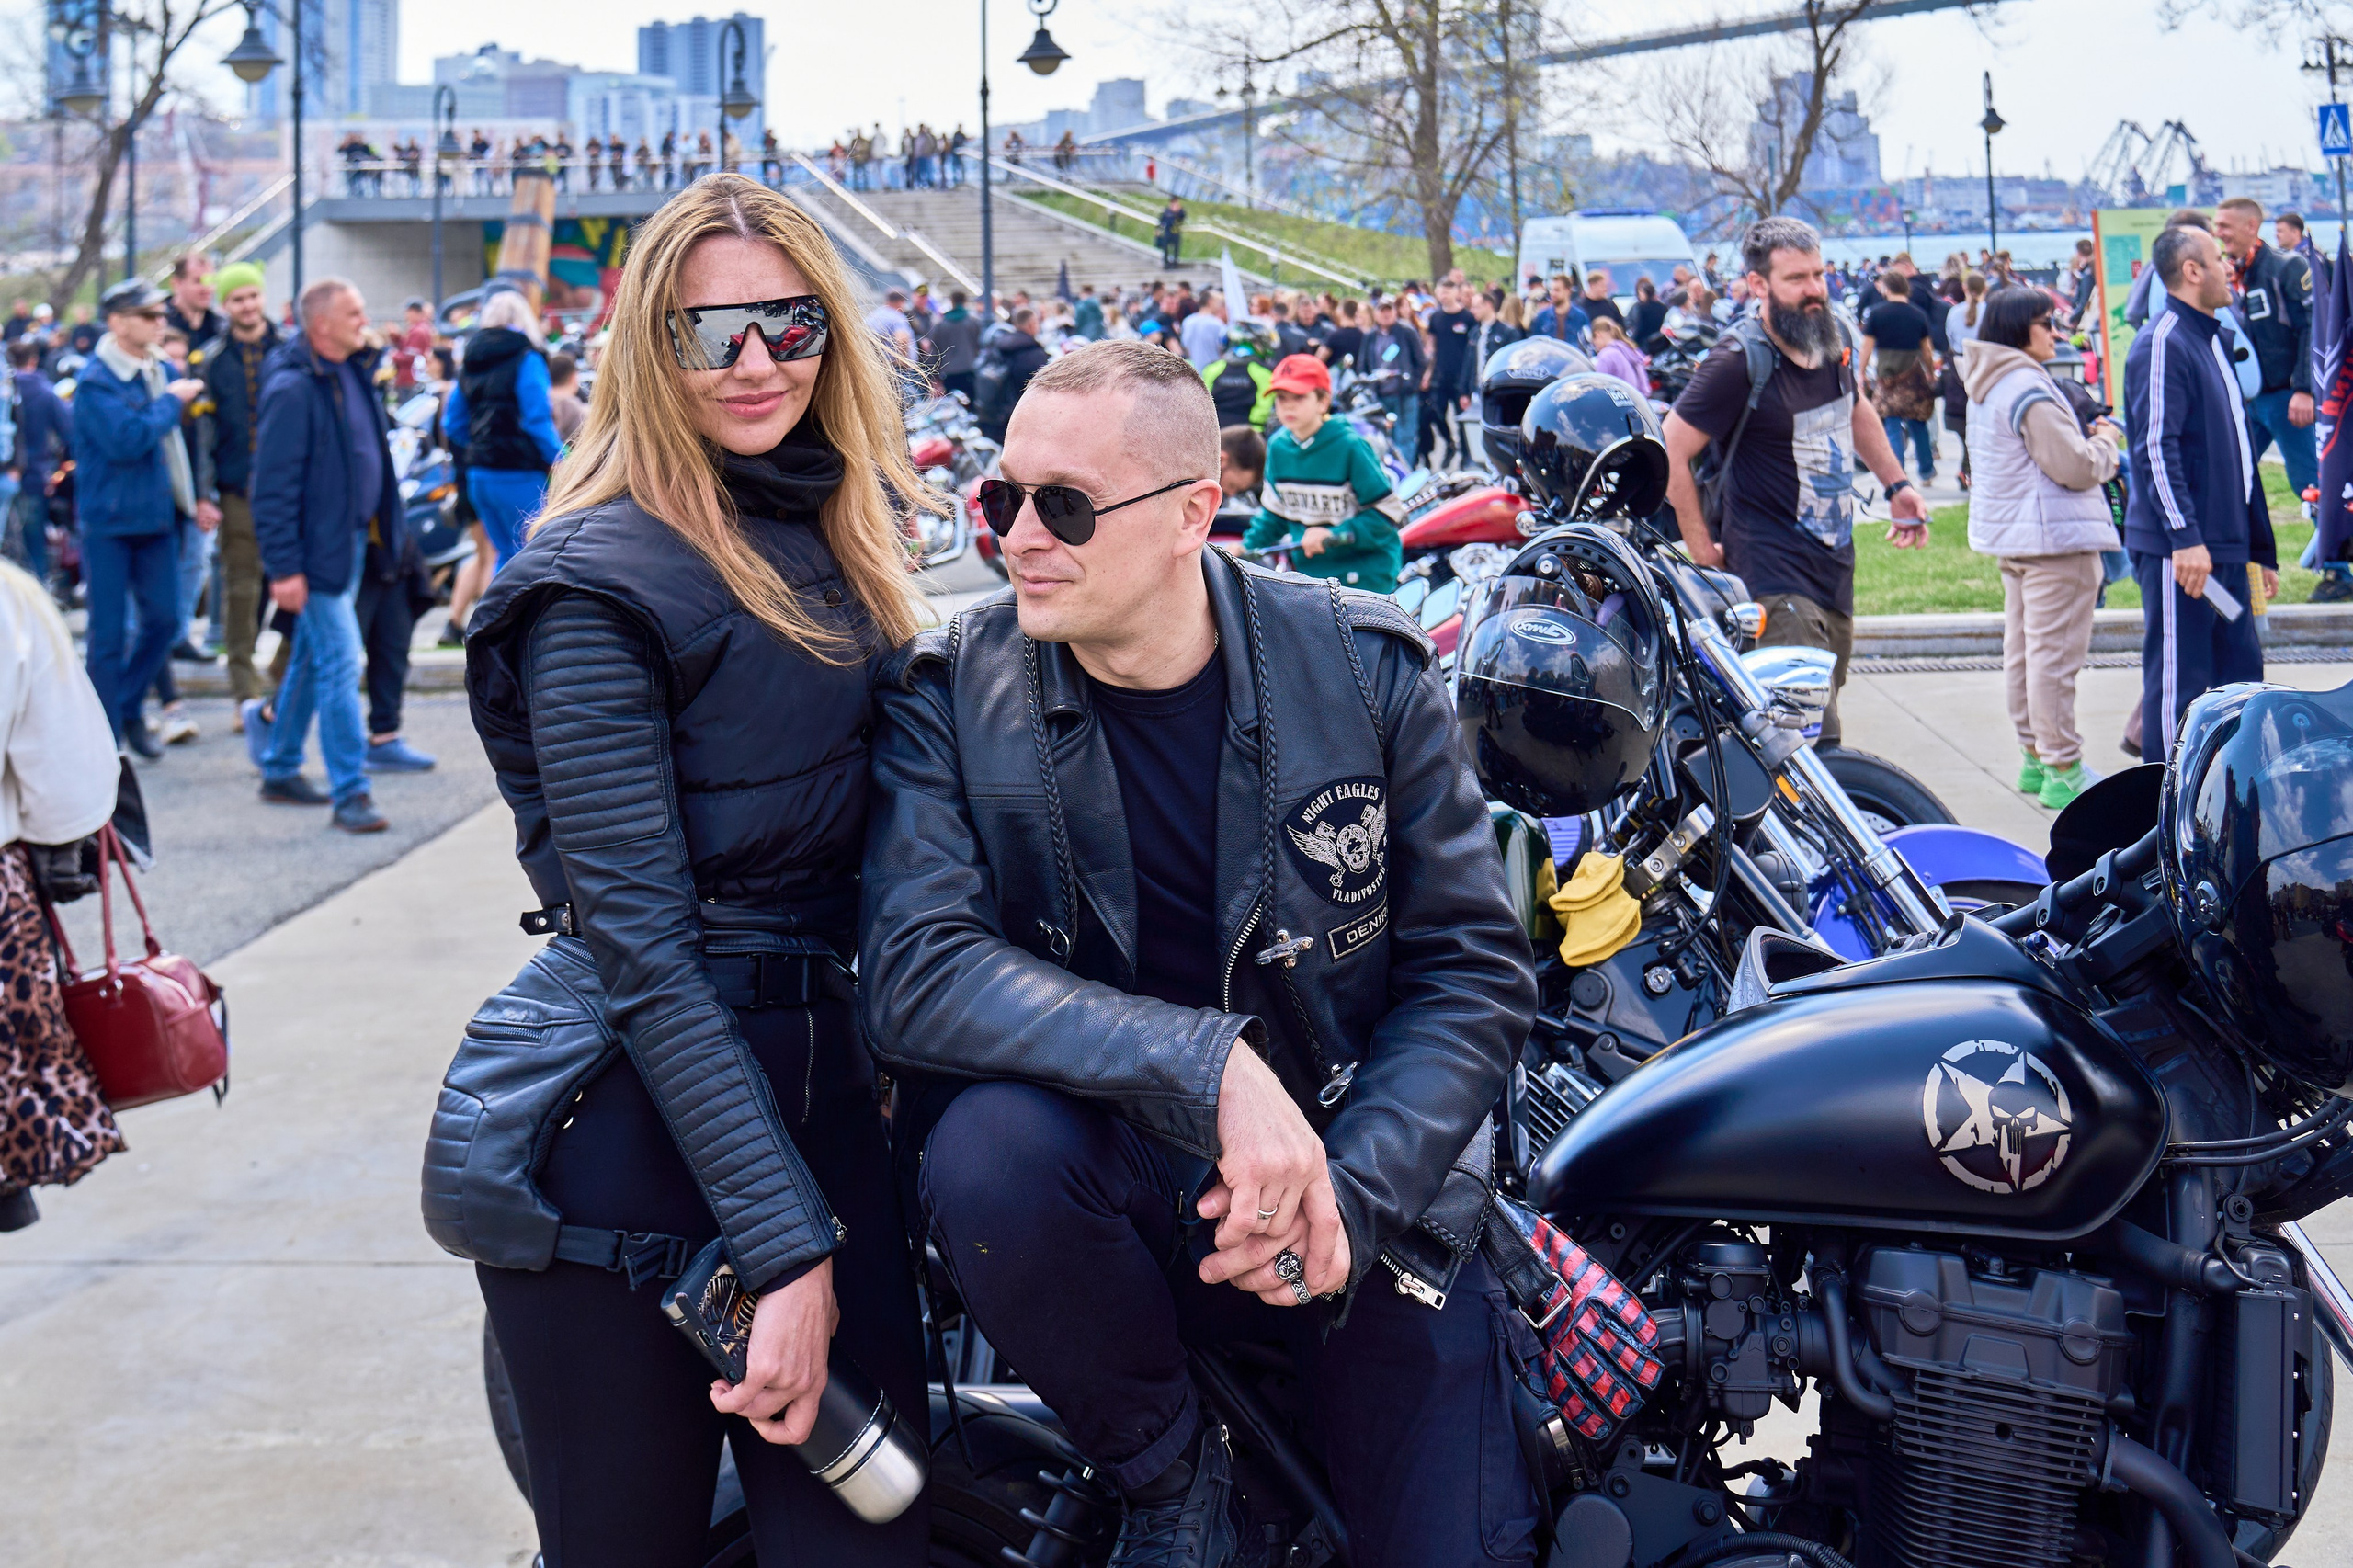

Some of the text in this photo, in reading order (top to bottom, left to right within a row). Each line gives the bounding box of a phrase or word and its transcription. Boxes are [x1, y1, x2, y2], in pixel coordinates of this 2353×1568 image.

[1301, 782, 1381, 825] NIGHT EAGLES
[1346, 906, 1389, 944] DENIR
